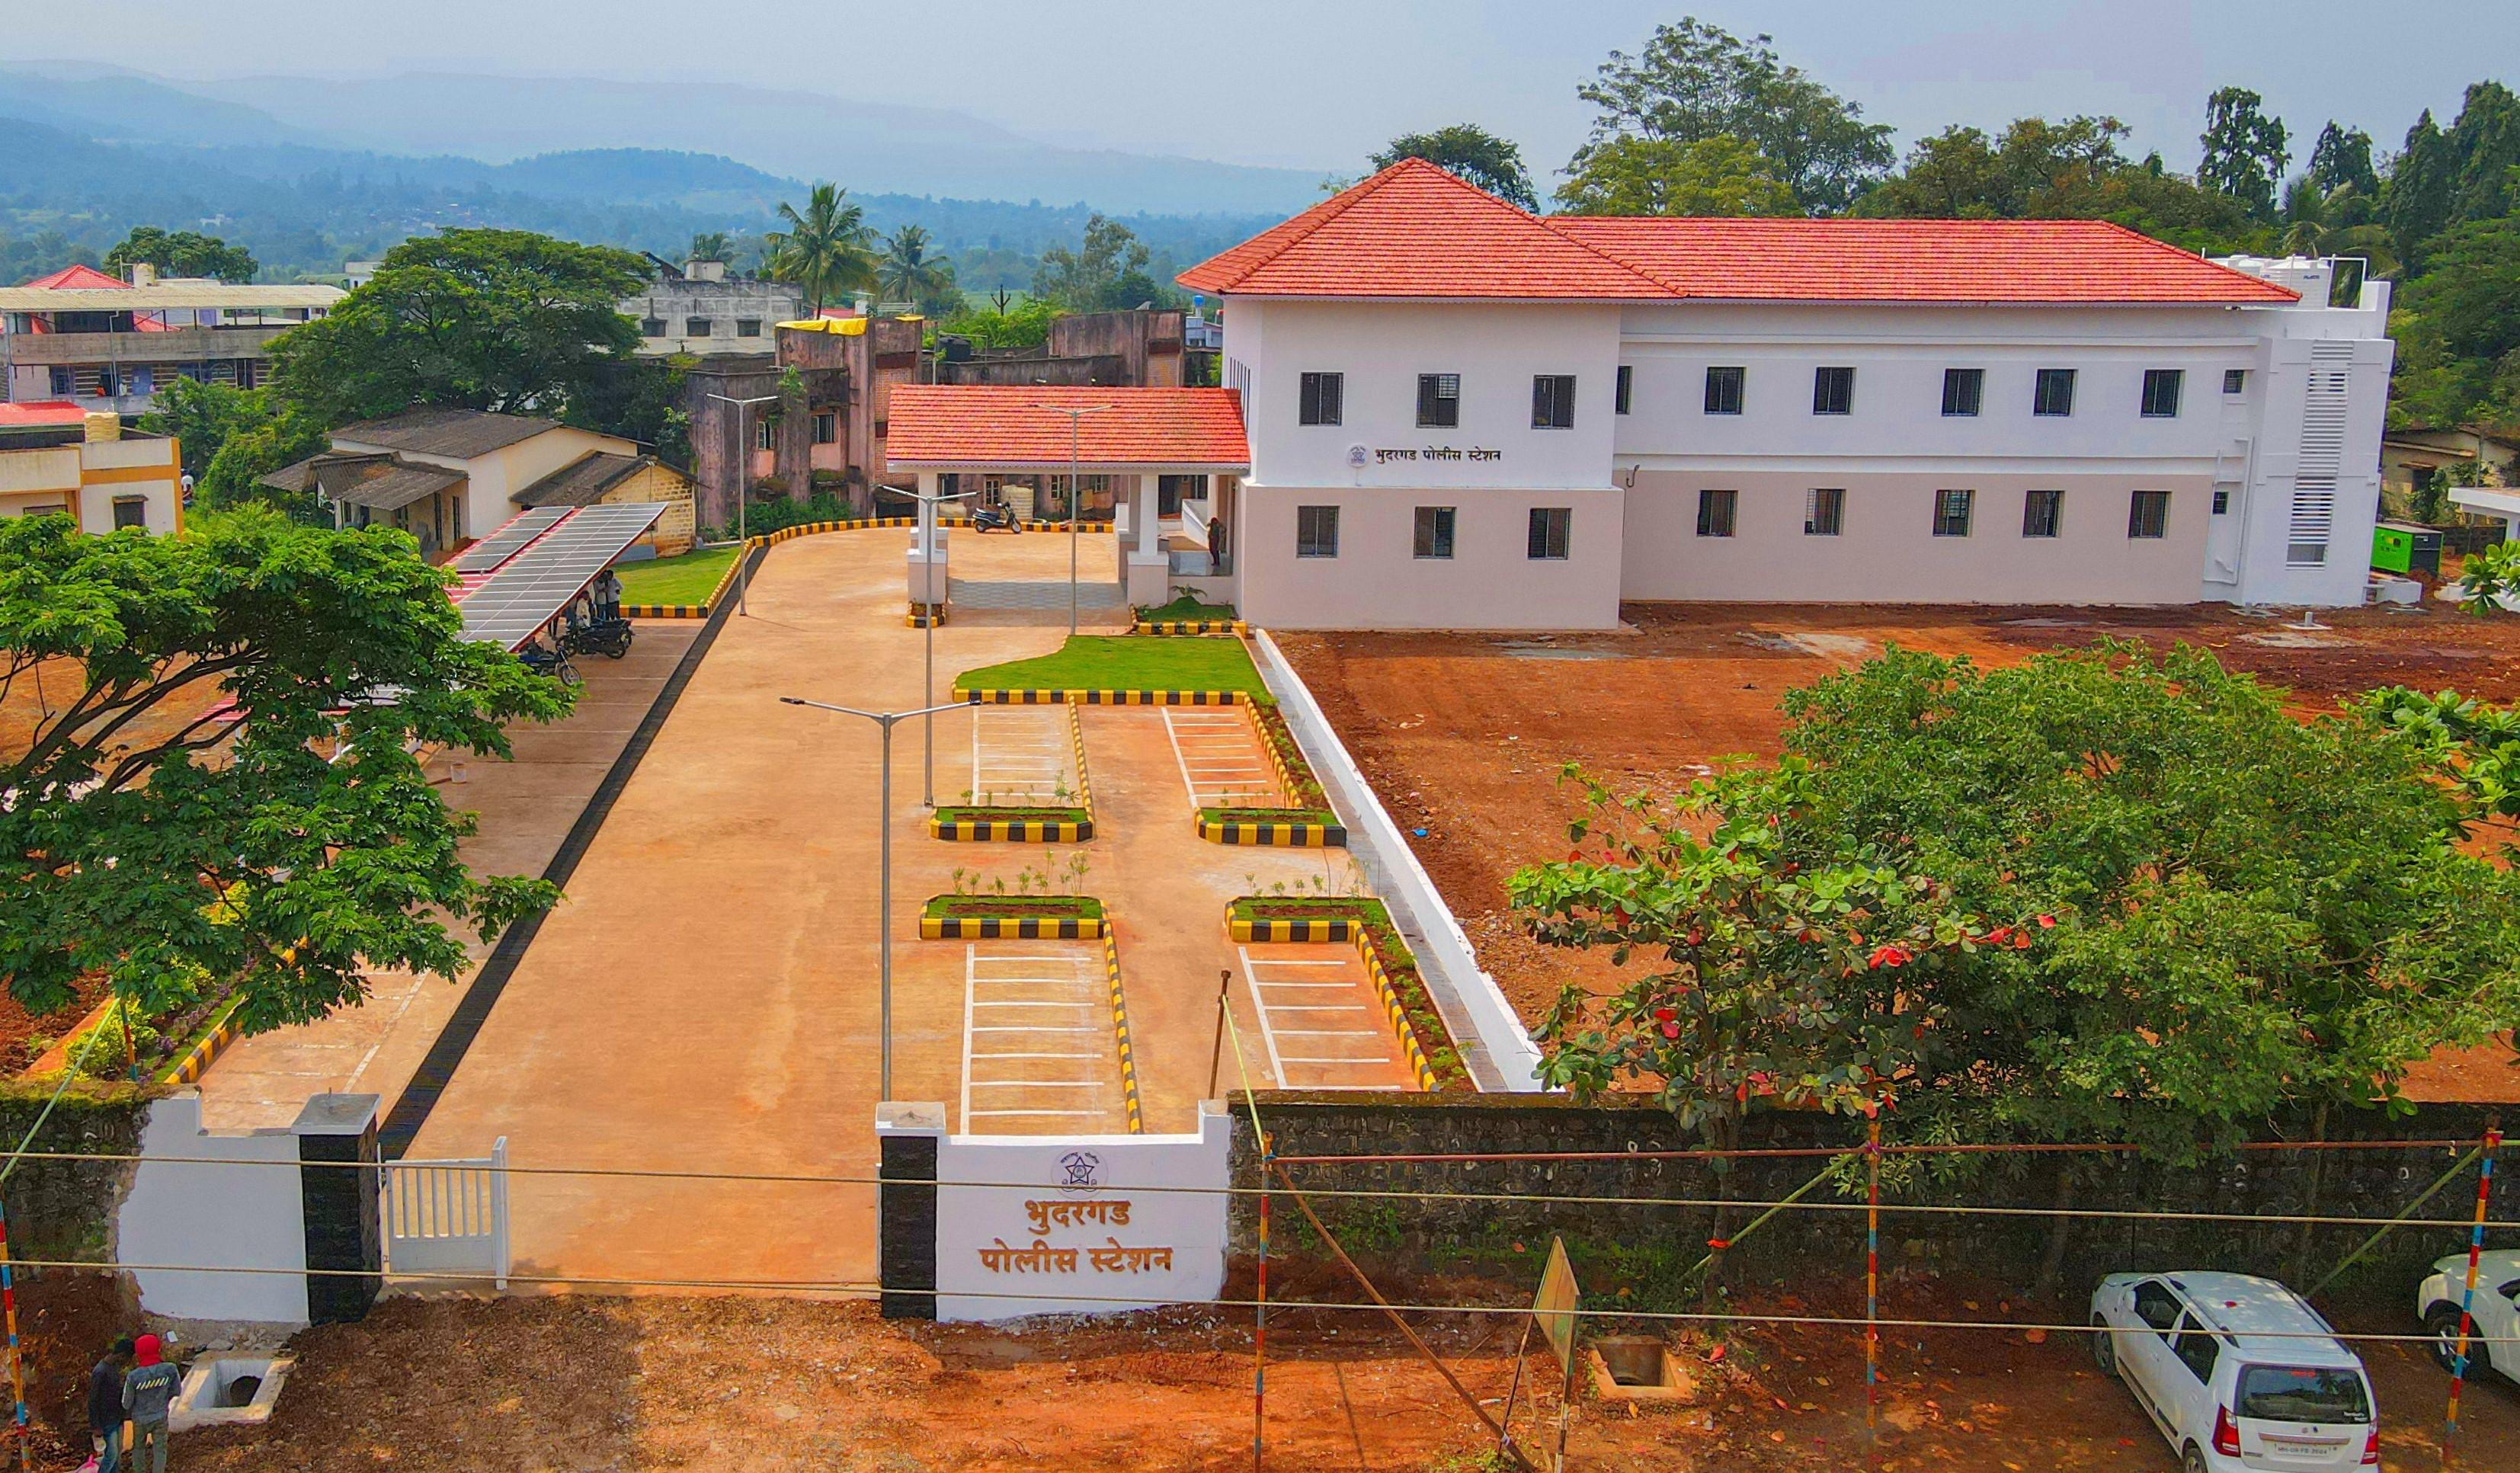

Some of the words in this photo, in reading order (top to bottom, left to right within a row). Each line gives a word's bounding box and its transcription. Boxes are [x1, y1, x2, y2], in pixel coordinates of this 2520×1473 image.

[1375, 449, 1417, 464] भुदरगड
[1423, 445, 1462, 461] पोलीस
[1467, 446, 1501, 462] स्टेशन
[1025, 1199, 1132, 1235] भुदरगड
[977, 1237, 1079, 1273] पोलीस
[1087, 1236, 1174, 1274] स्टेशन
